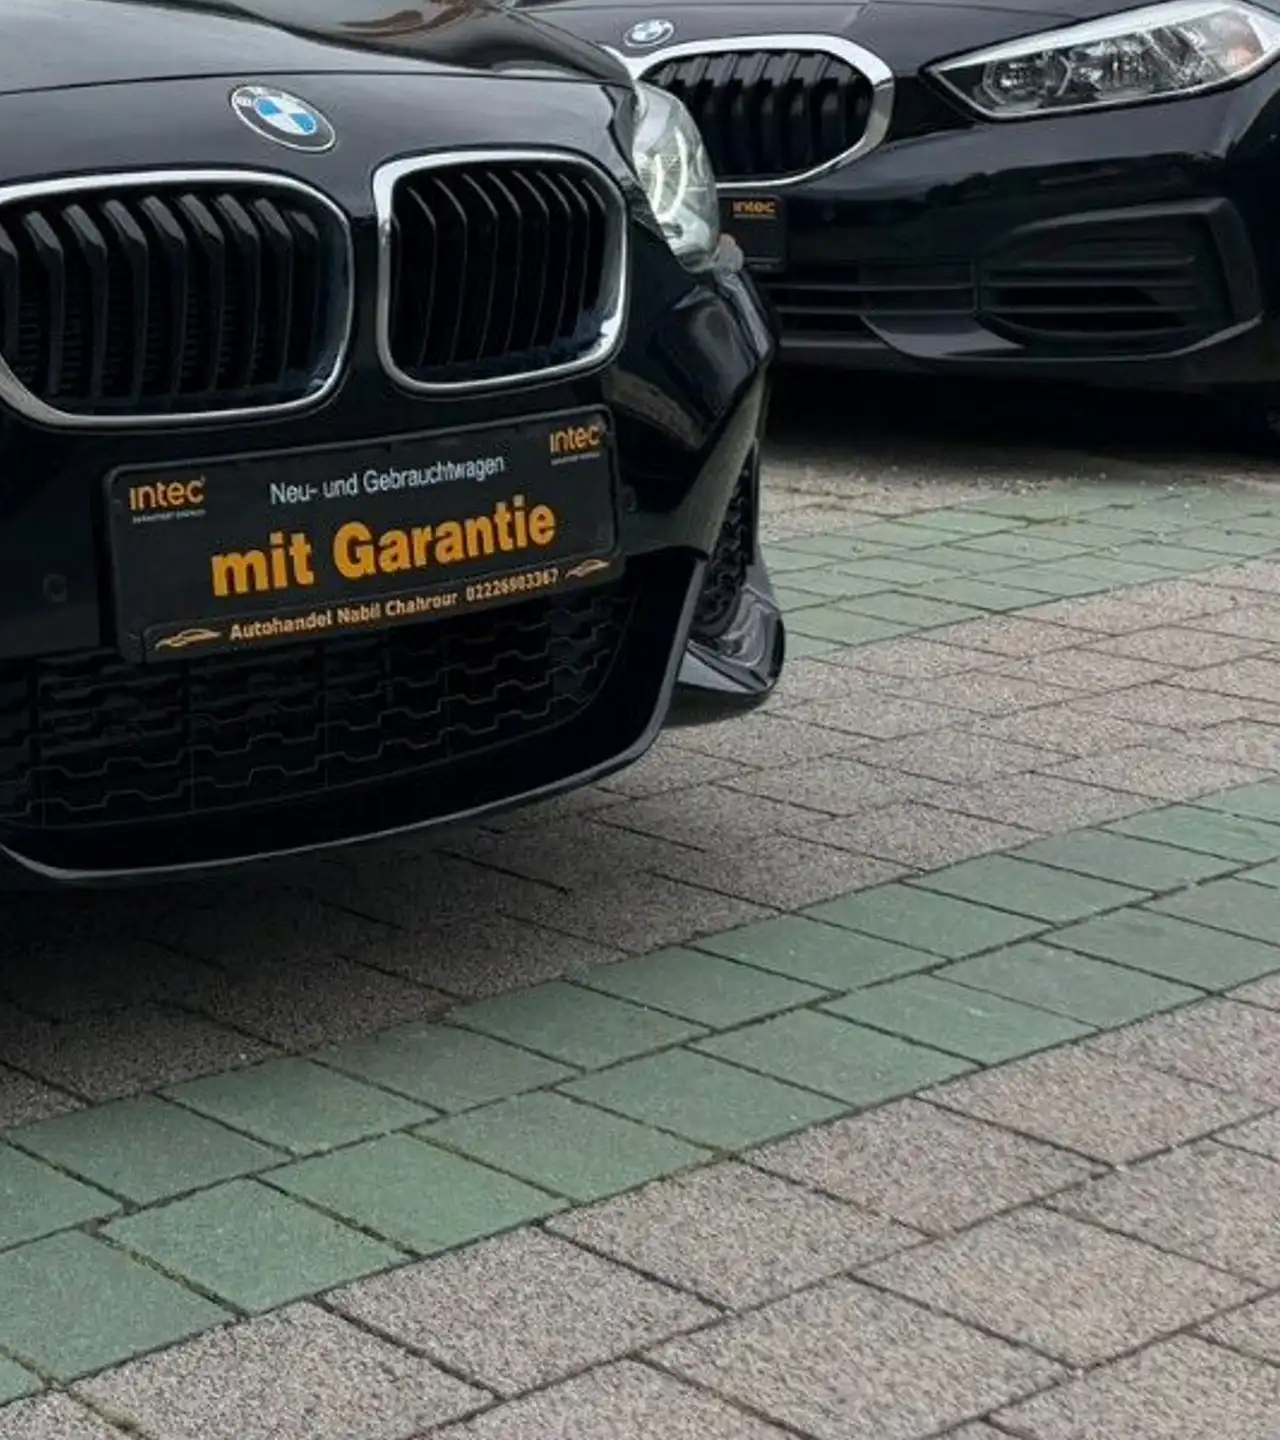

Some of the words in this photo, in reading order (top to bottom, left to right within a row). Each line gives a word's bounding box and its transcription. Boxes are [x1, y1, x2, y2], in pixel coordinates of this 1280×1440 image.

[129, 479, 205, 511] intec
[269, 482, 318, 505] Neu-
[322, 472, 359, 498] und
[362, 456, 505, 494] Gebrauchtwagen
[211, 529, 315, 598] mit
[332, 494, 557, 580] Garantie
[230, 611, 333, 641] Autohandel
[336, 601, 381, 624] Nabil
[385, 591, 459, 616] Chahrour
